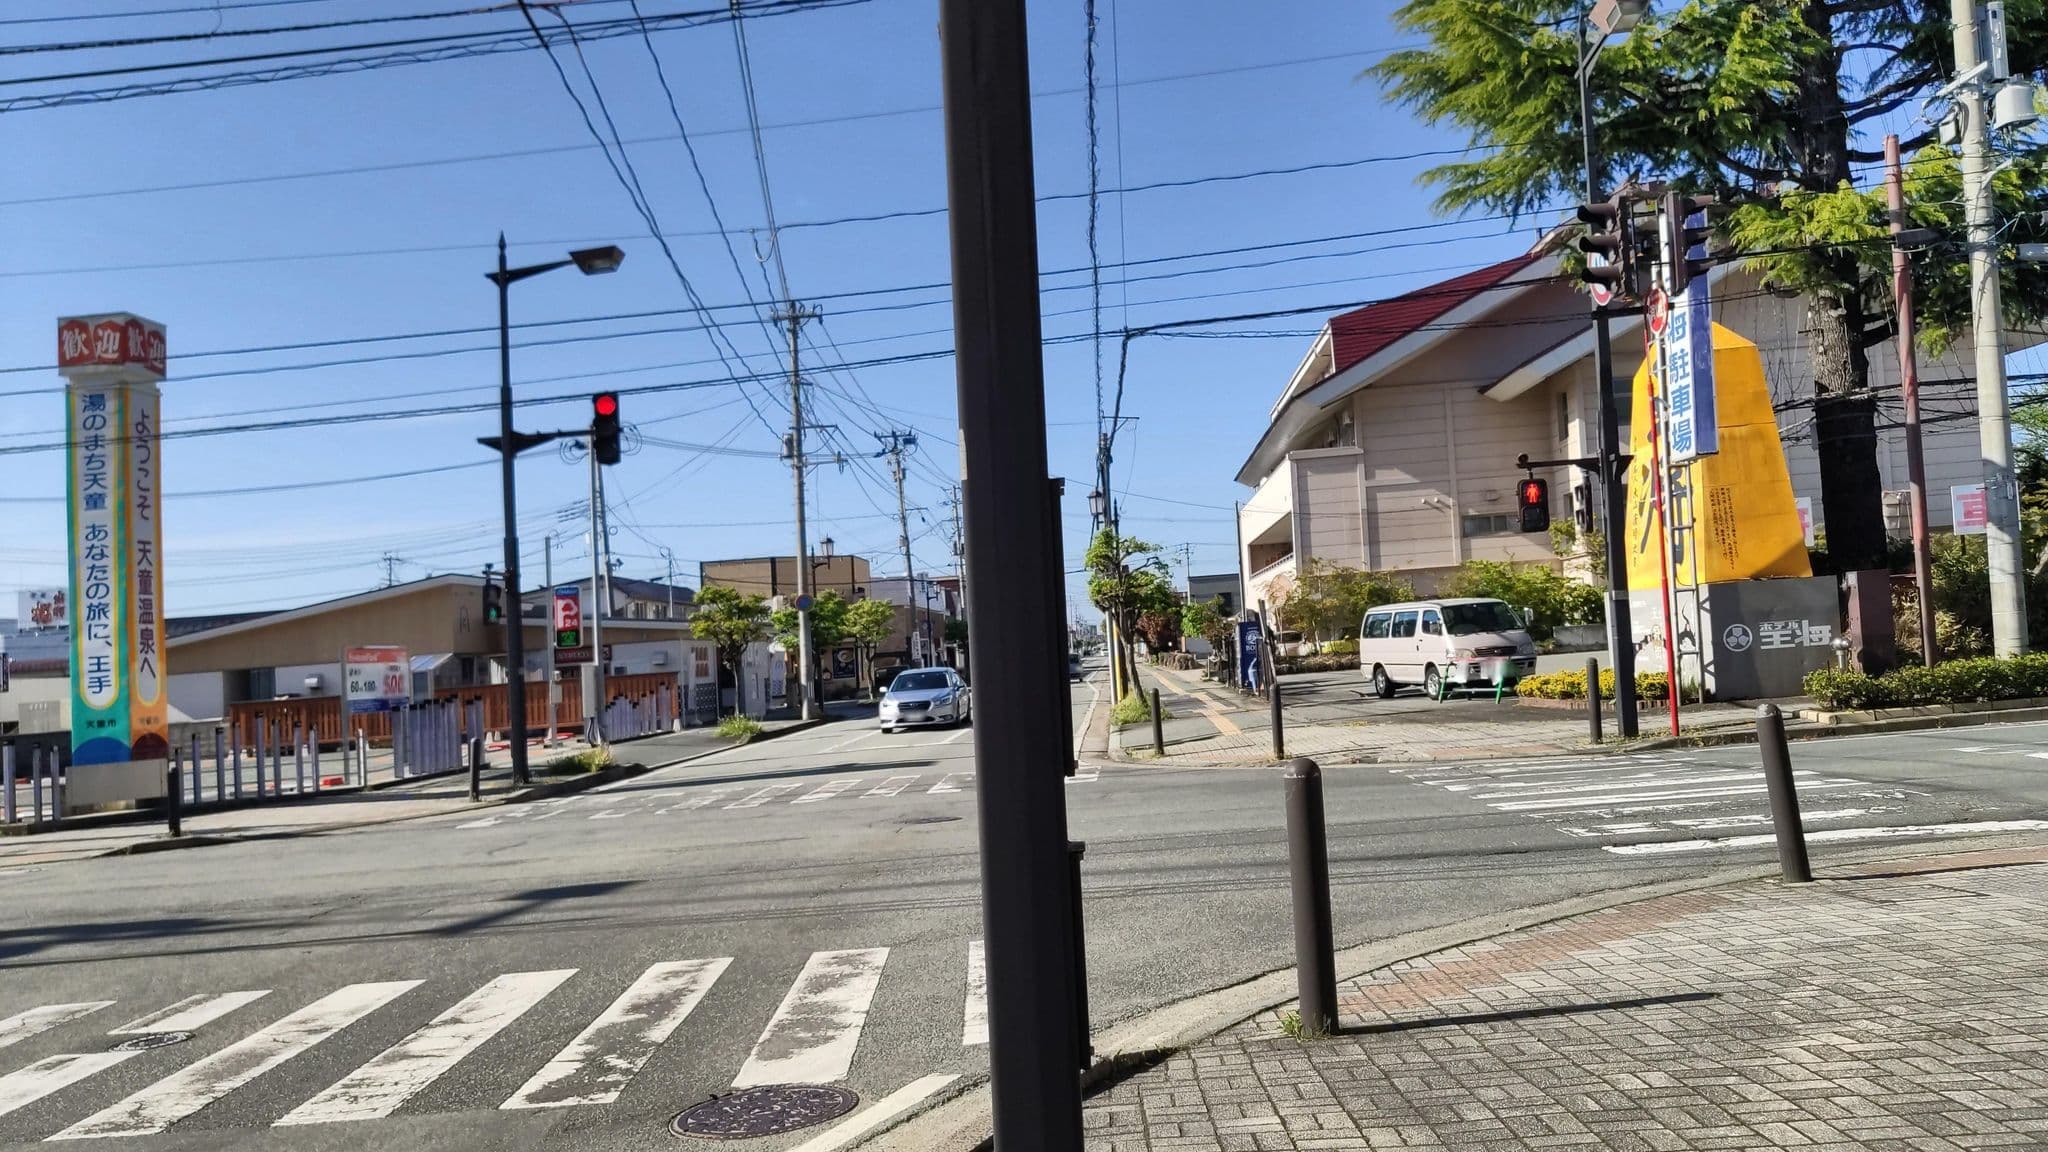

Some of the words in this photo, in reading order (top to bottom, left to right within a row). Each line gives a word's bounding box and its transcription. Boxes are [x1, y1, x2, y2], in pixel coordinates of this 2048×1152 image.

[62, 328, 120, 361] 歓迎
[82, 393, 107, 511] 湯のまち天童
[135, 408, 151, 520] ようこそ
[137, 541, 156, 679] 天童温泉へ
[1760, 621, 1800, 631] ホテル
[1760, 620, 1832, 649] 王将
[87, 655, 112, 694] 王手
